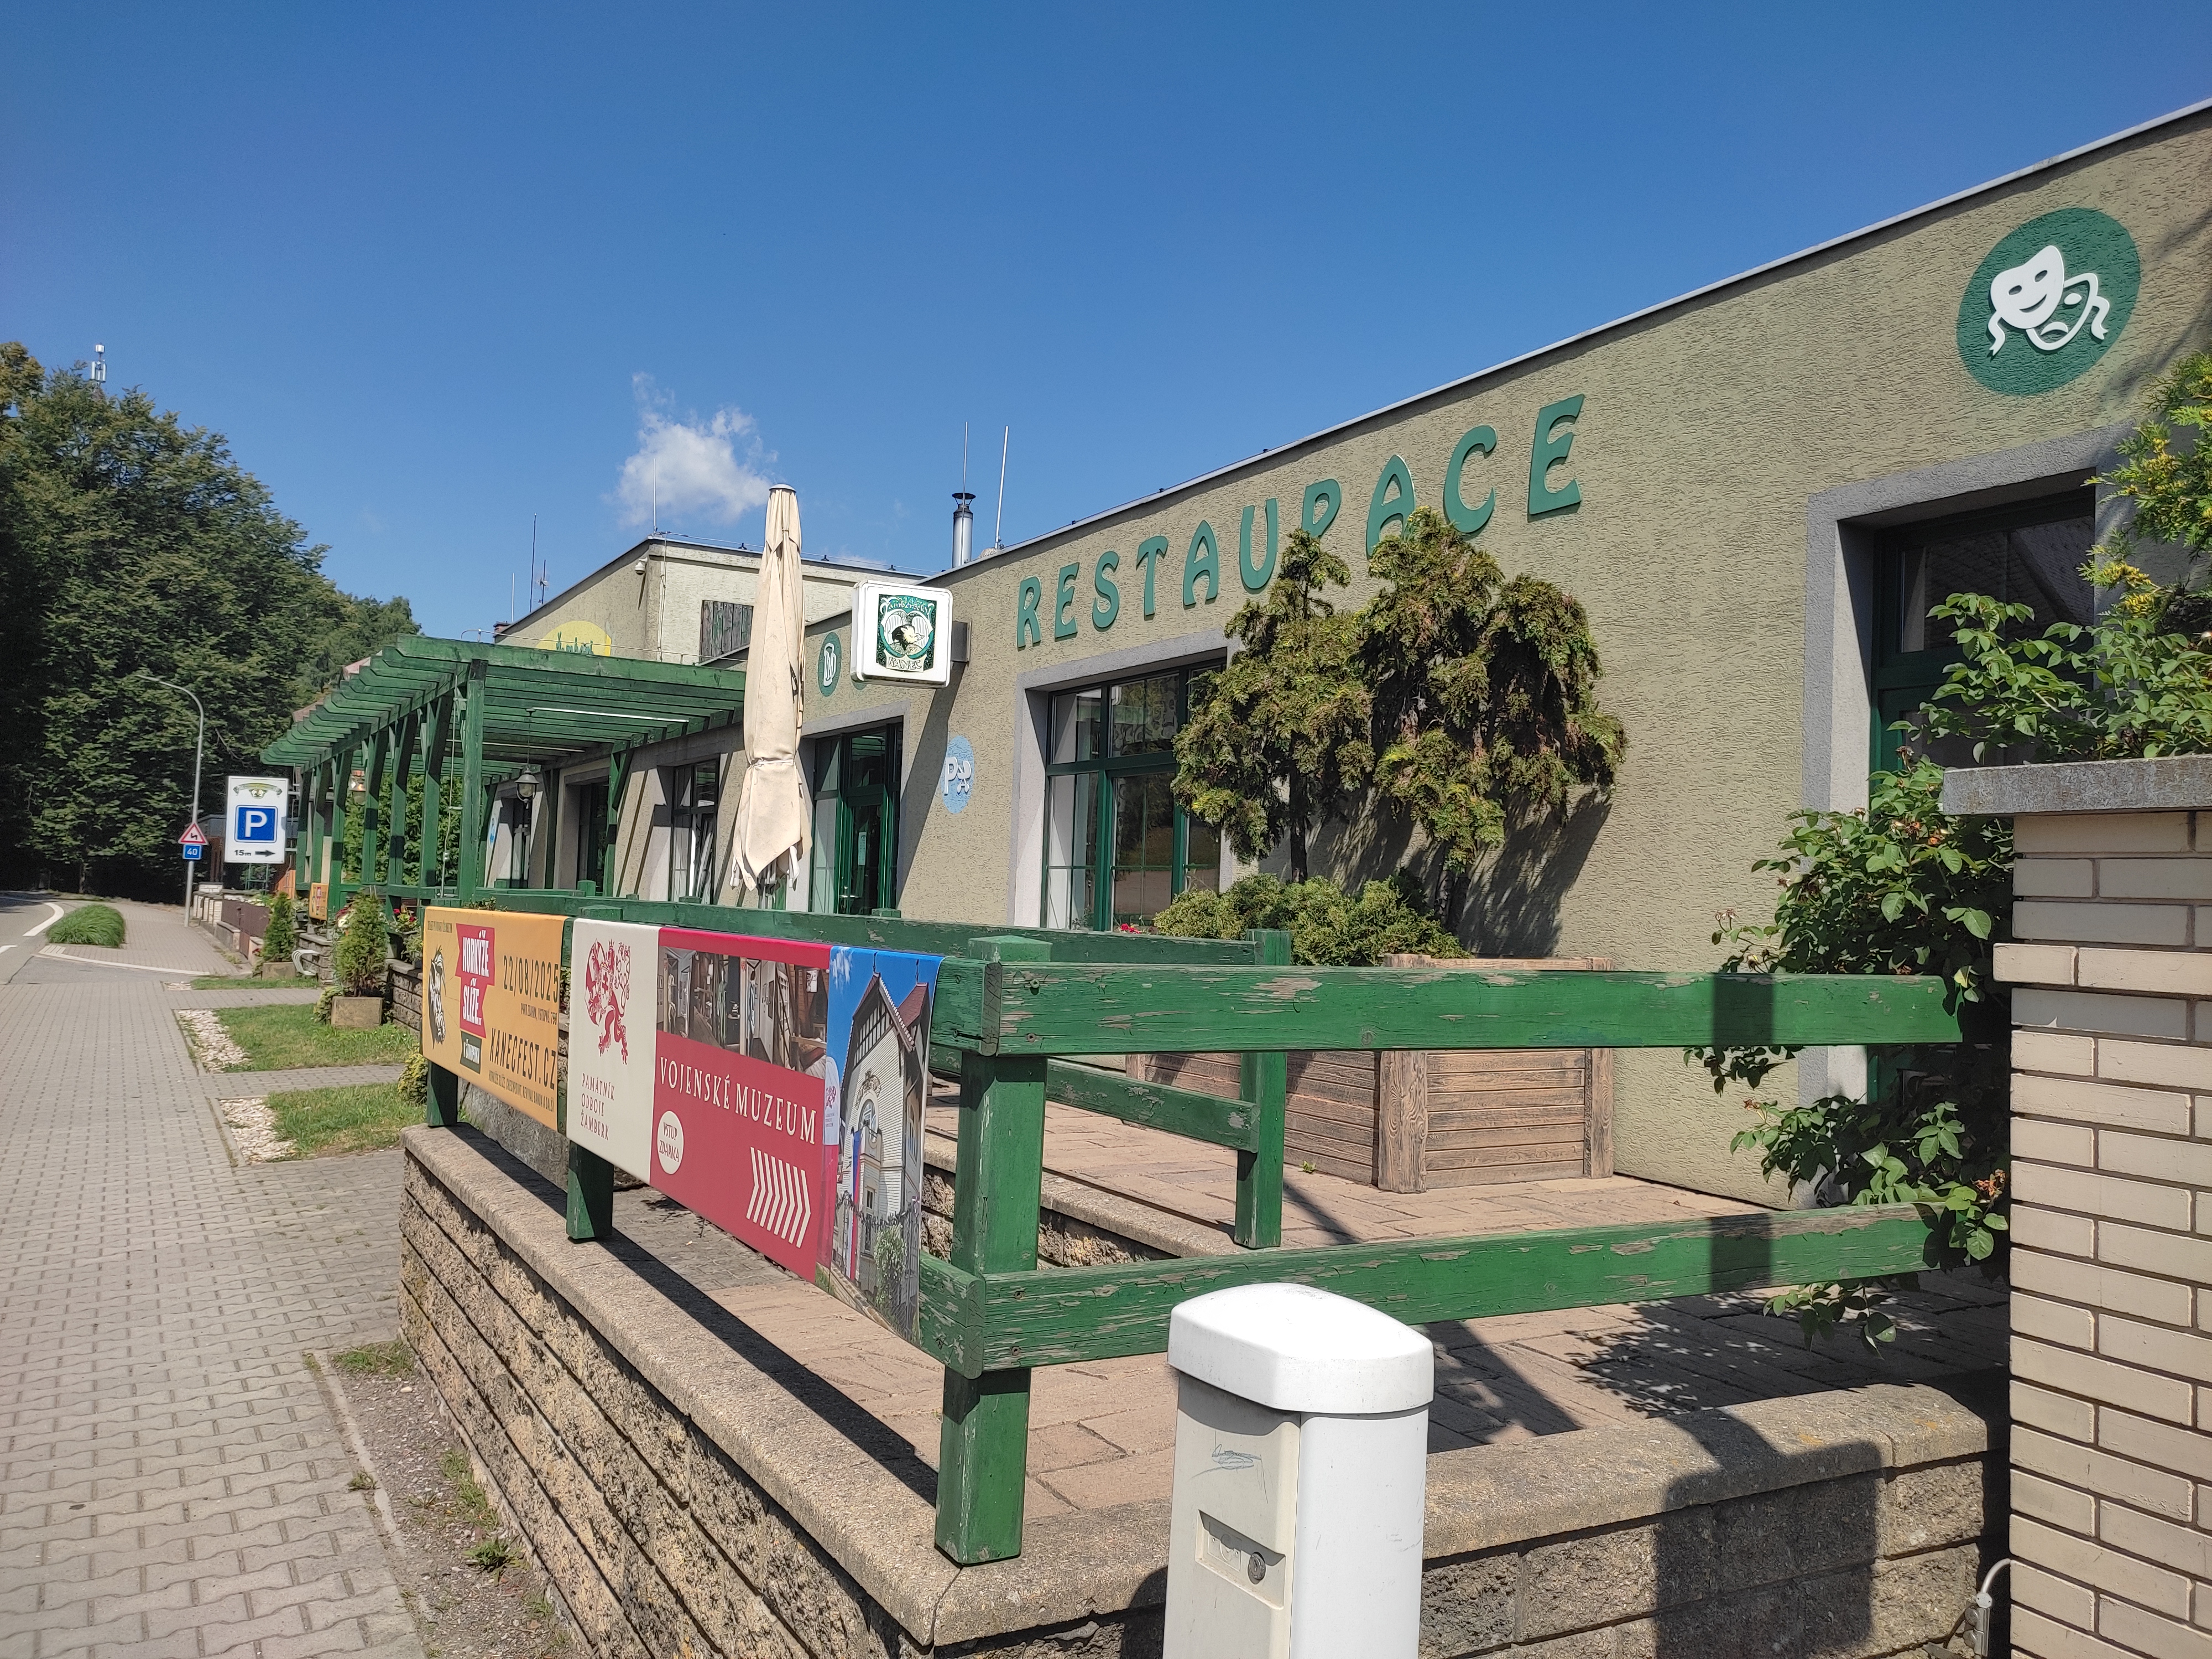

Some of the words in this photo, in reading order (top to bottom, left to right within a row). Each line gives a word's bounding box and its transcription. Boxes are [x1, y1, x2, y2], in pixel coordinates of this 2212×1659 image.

[1016, 393, 1585, 648] RESTAURACE
[888, 656, 922, 670] KANEC
[245, 810, 268, 838] P
[462, 930, 489, 977] HORKÝŽE
[504, 955, 559, 1003] 22/08/2025
[489, 1027, 556, 1091] KANECFEST.CZ
[582, 1073, 615, 1101] PAMÁTNÍK
[660, 1056, 731, 1110] VOJENSKÉ
[735, 1083, 817, 1145] MUZEUM
[581, 1093, 604, 1117] ODBOJE
[581, 1109, 609, 1141] ŽAMBERK
[663, 1122, 678, 1141] VSTUP
[659, 1140, 680, 1162] ZDARMA
